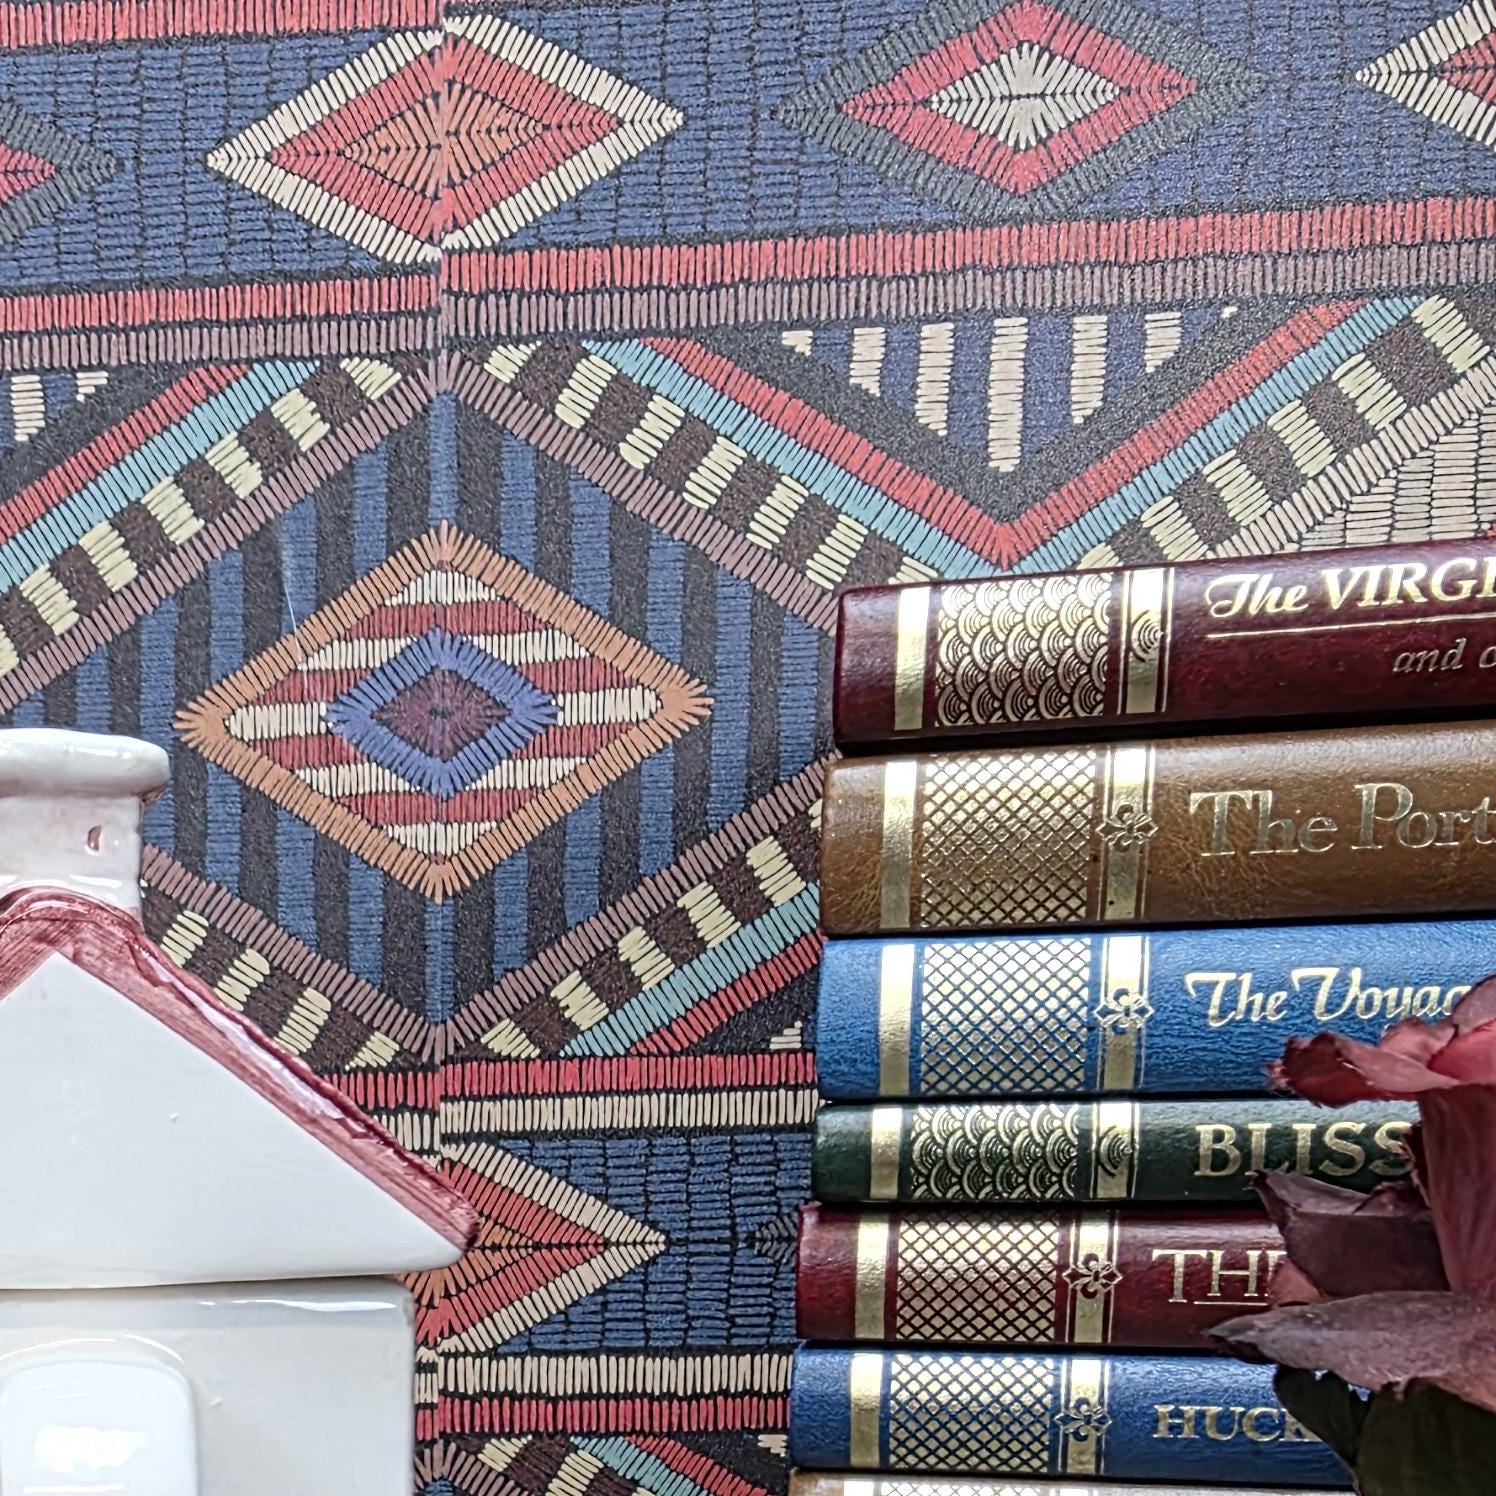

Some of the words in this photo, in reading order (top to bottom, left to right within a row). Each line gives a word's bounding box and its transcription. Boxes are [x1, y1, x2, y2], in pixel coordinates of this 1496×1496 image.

[1205, 572, 1310, 618] The
[1392, 637, 1467, 673] and
[1189, 789, 1338, 857] The
[1351, 781, 1496, 850] Port
[1185, 972, 1288, 1028] The
[1193, 1121, 1413, 1177] BLISS
